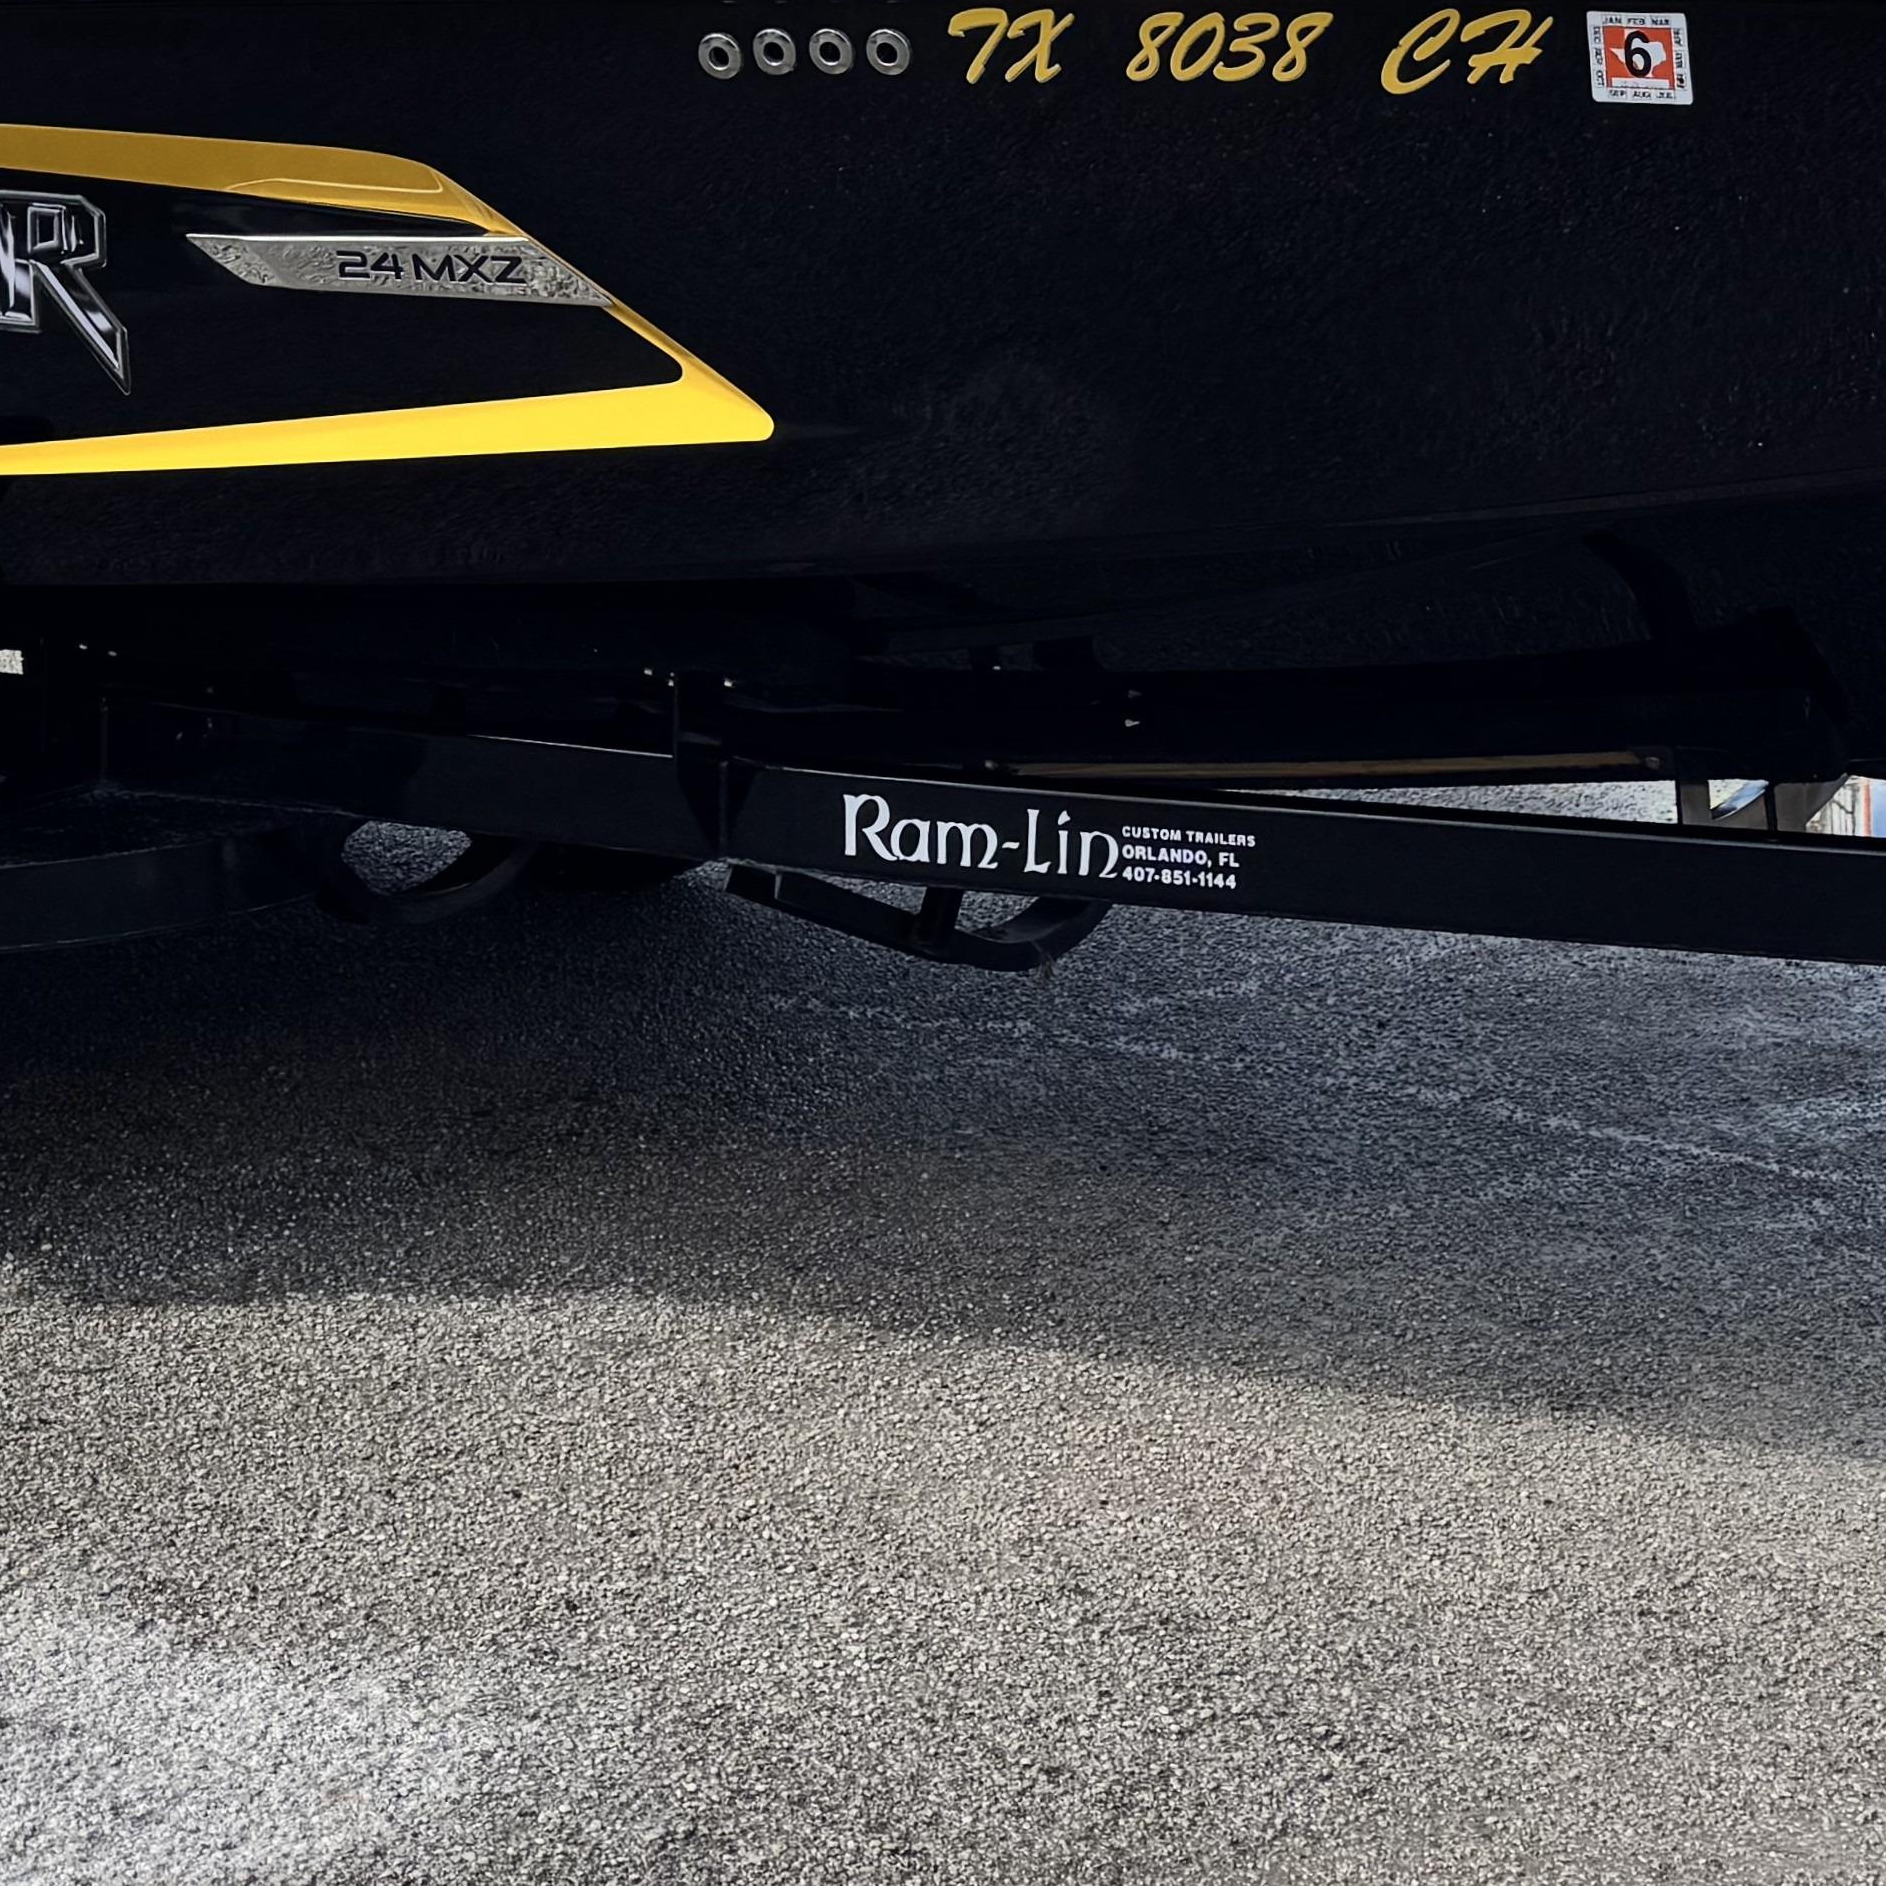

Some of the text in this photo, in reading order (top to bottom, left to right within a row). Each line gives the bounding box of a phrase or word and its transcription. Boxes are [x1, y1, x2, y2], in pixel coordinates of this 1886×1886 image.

[948, 8, 1553, 96] TX 8038 CH
[1624, 30, 1652, 78] 6
[336, 251, 527, 284] 24 MXZ
[843, 794, 1255, 878] Ram-Lin CUSTOM TRAILERS
[1122, 844, 1240, 868] ORLANDO, FL
[1122, 866, 1236, 889] 407-851-1144
